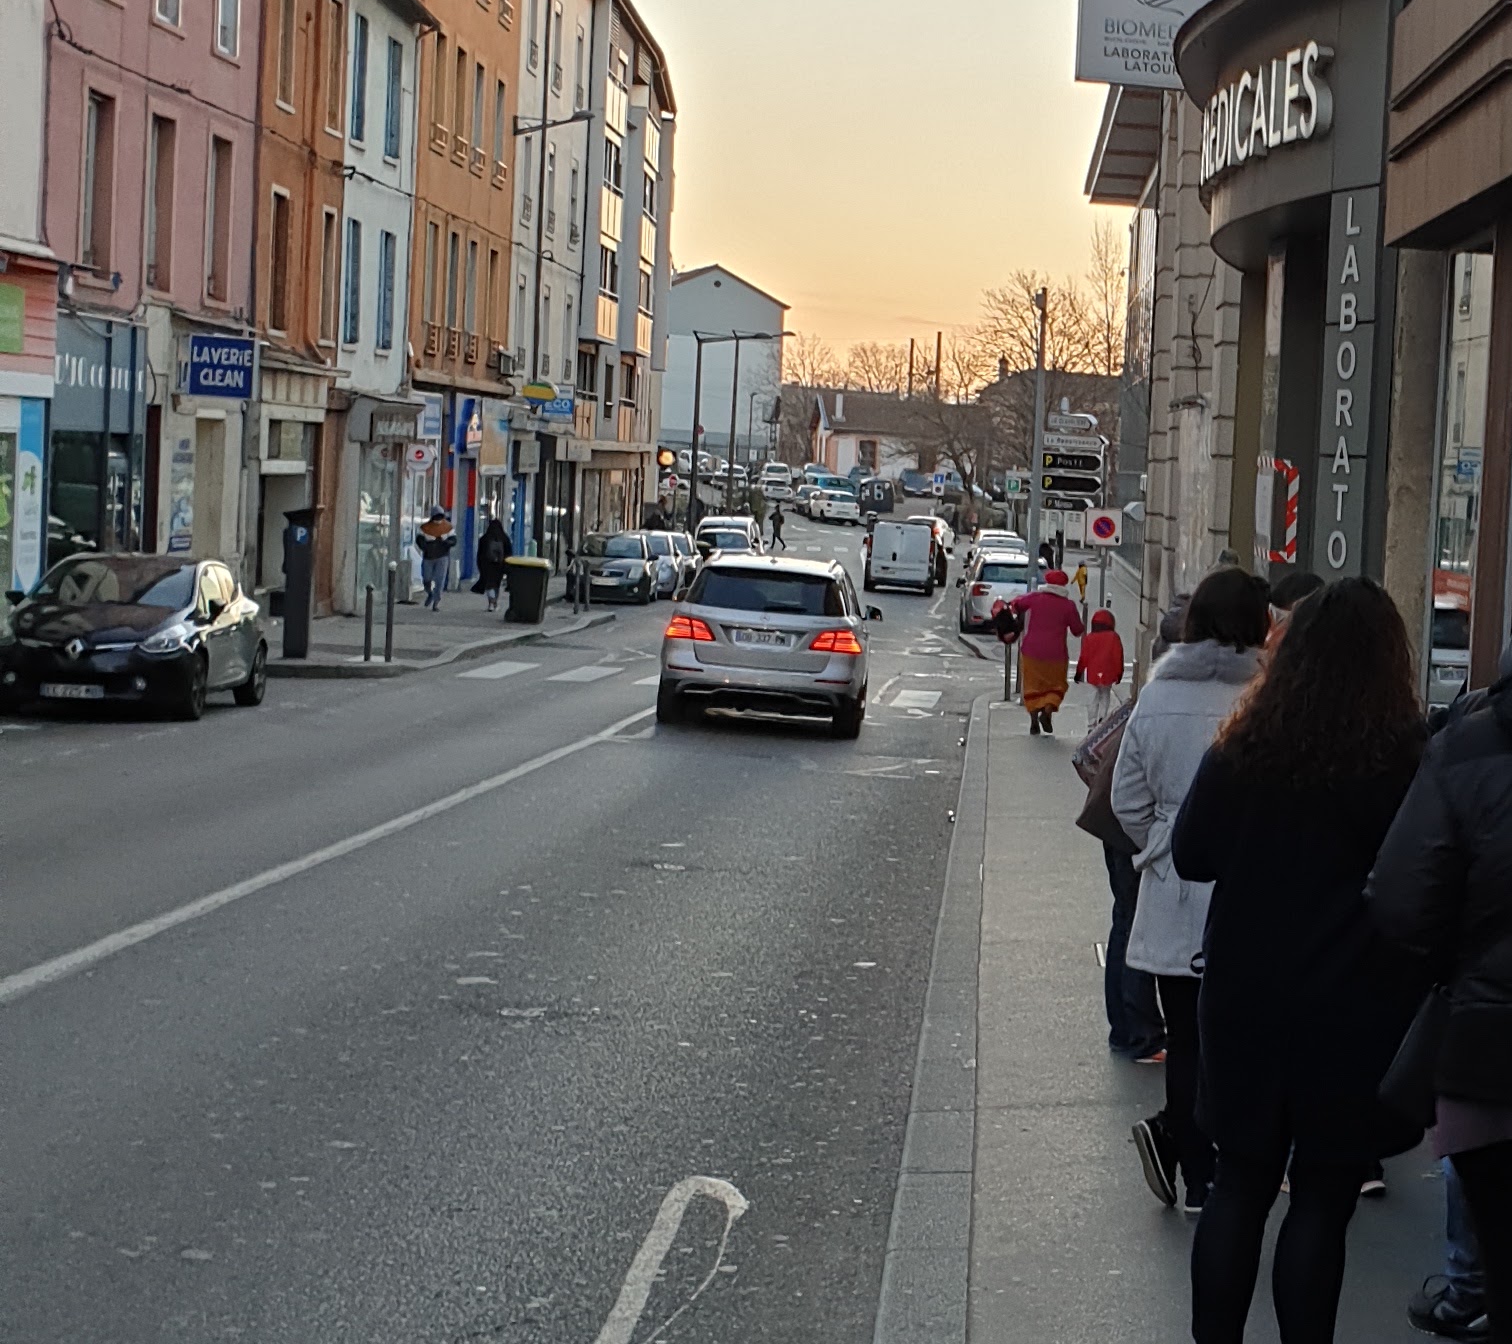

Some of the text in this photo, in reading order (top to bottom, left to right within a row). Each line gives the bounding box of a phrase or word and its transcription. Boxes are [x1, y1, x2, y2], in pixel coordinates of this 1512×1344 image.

[1124, 60, 1177, 76] LATOU
[199, 367, 244, 389] CLEAN
[1327, 196, 1360, 569] LABORATO
[296, 527, 307, 542] P
